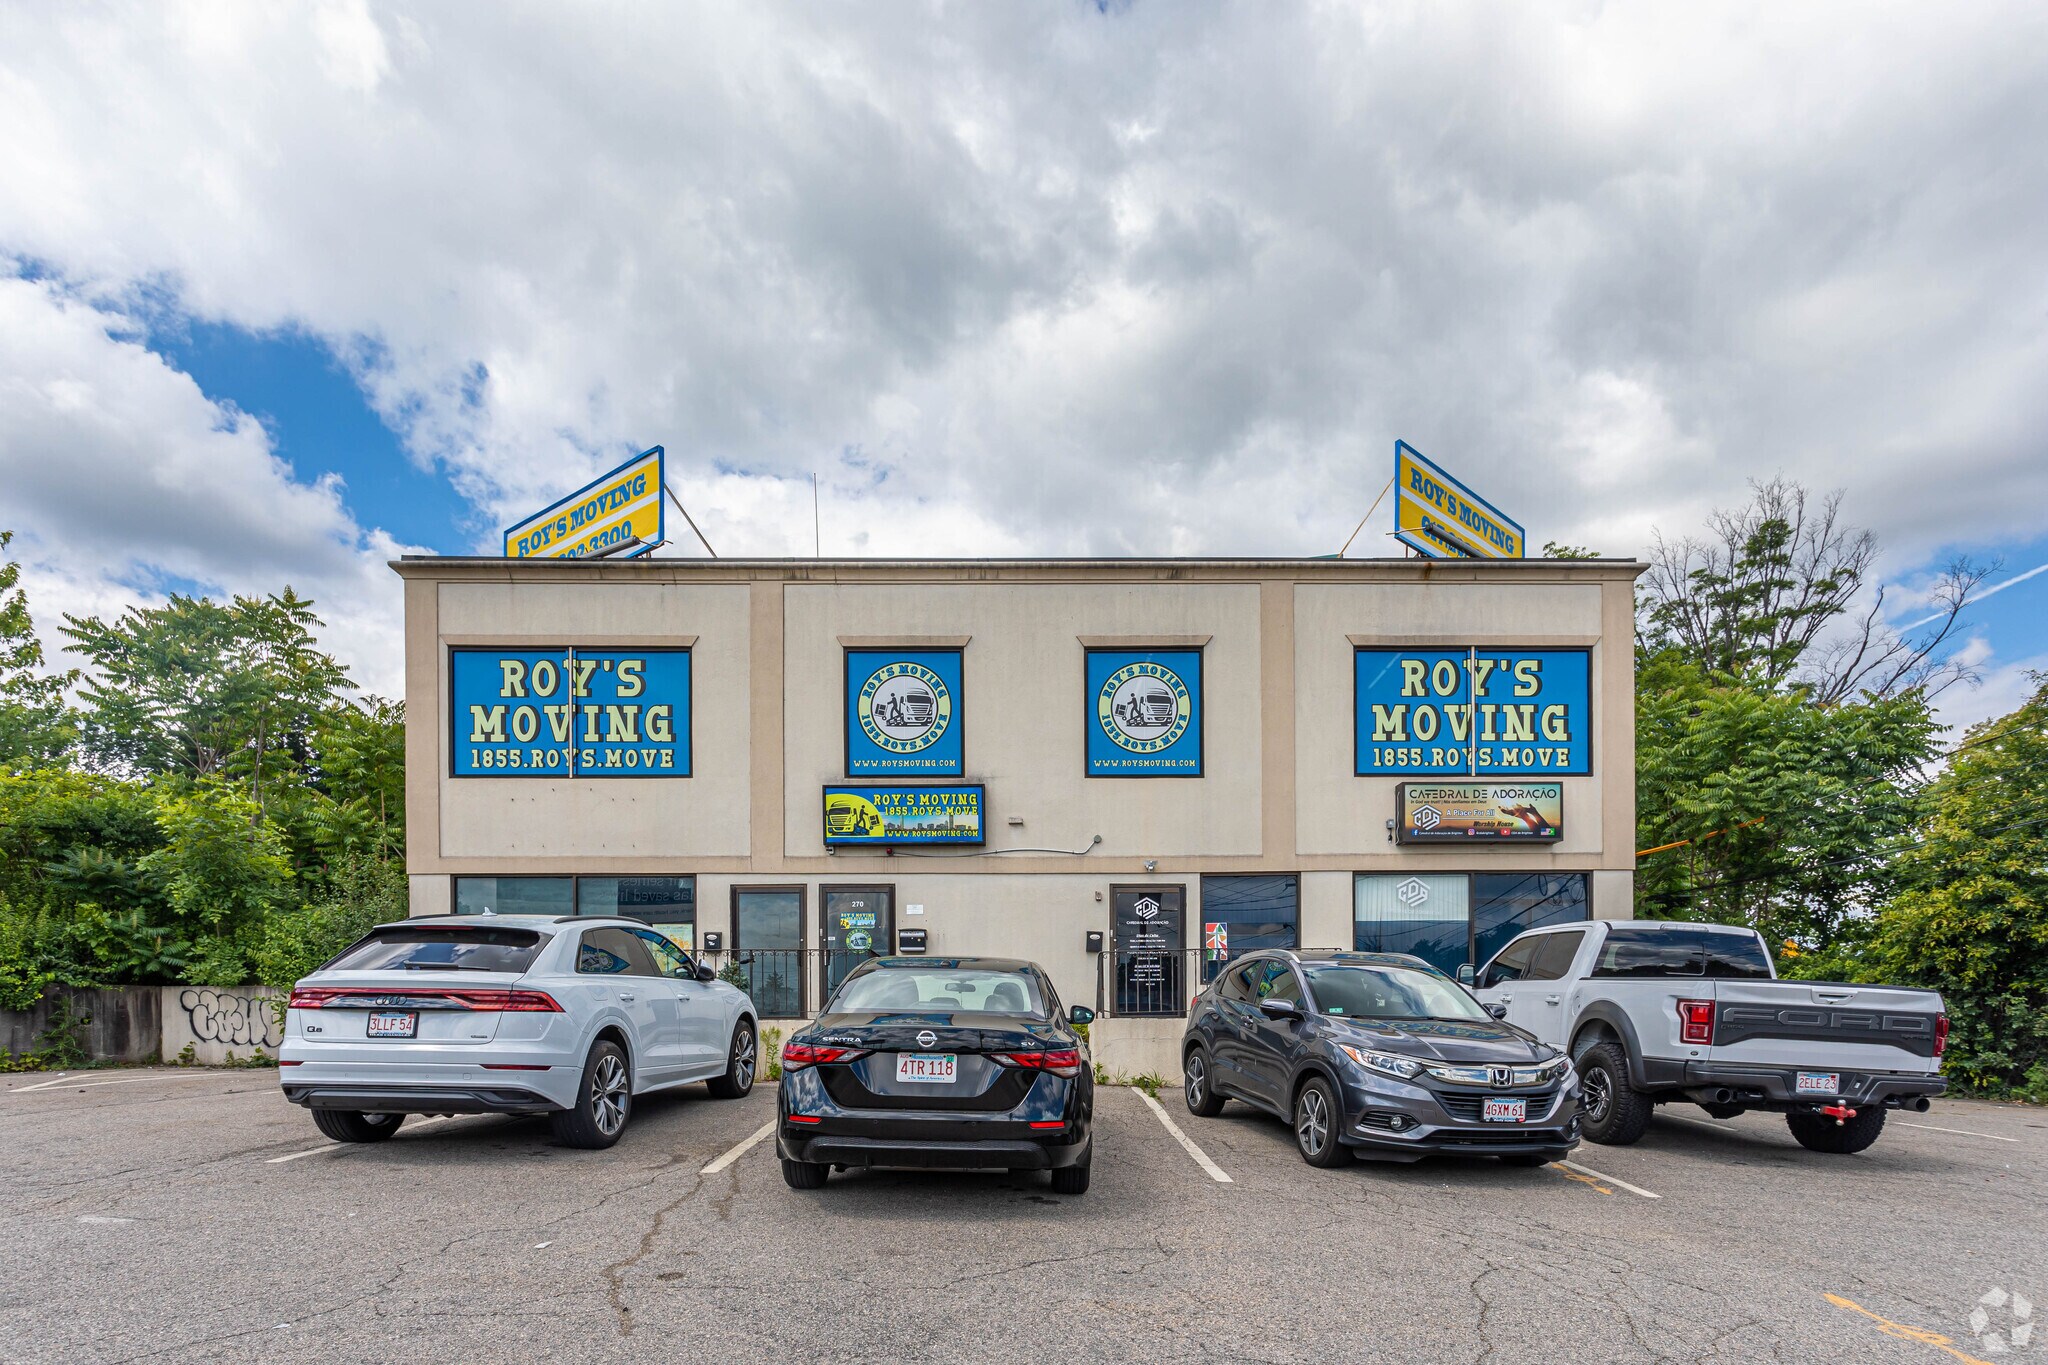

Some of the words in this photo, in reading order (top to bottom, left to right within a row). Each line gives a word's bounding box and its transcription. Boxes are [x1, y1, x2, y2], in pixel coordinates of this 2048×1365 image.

[517, 515, 567, 558] ROY'S
[570, 473, 647, 531] MOVING
[1410, 467, 1457, 516] ROY'S
[1459, 501, 1515, 555] MOVING
[499, 658, 647, 698] ROY'S
[862, 666, 895, 699] ROY'S
[898, 664, 948, 699] MOVING
[1102, 666, 1135, 699] ROY'S
[1138, 664, 1187, 699] MOVING
[1401, 659, 1543, 697] ROY'S
[470, 704, 677, 743] MOVING
[862, 714, 948, 751] 1855.ROYS.MOVE
[1102, 714, 1188, 751] 1855.ROYS.MOVE
[1371, 704, 1572, 742] MOVING
[471, 748, 676, 768] 1855.ROYS.MOVE
[854, 759, 956, 767] WWW.ROYSMOVING.COM
[1094, 759, 1196, 767] WWW.ROYSMOVING.COM
[1373, 748, 1571, 767] 1855.ROYS.MOVE
[873, 794, 915, 806] ROY'S
[919, 794, 978, 805] MOVING
[1409, 789, 1469, 799] CATEDRAL
[1473, 789, 1488, 799] DE
[1491, 788, 1557, 801] ADORAÇÃO
[885, 806, 978, 816] 1855.ROYS.MOVE
[887, 830, 979, 838] WWW.ROYSMOVING.COM
[851, 900, 864, 908] 270
[370, 1018, 397, 1031] 3LLF
[400, 1018, 412, 1031] 54
[1722, 1007, 1931, 1033] FORD
[900, 1060, 925, 1075] 4TR
[929, 1060, 954, 1076] 118
[1799, 1077, 1822, 1089] 2ELE
[1824, 1078, 1837, 1090] 23
[1485, 1103, 1510, 1116] 4GXM
[1511, 1104, 1524, 1117] 61
